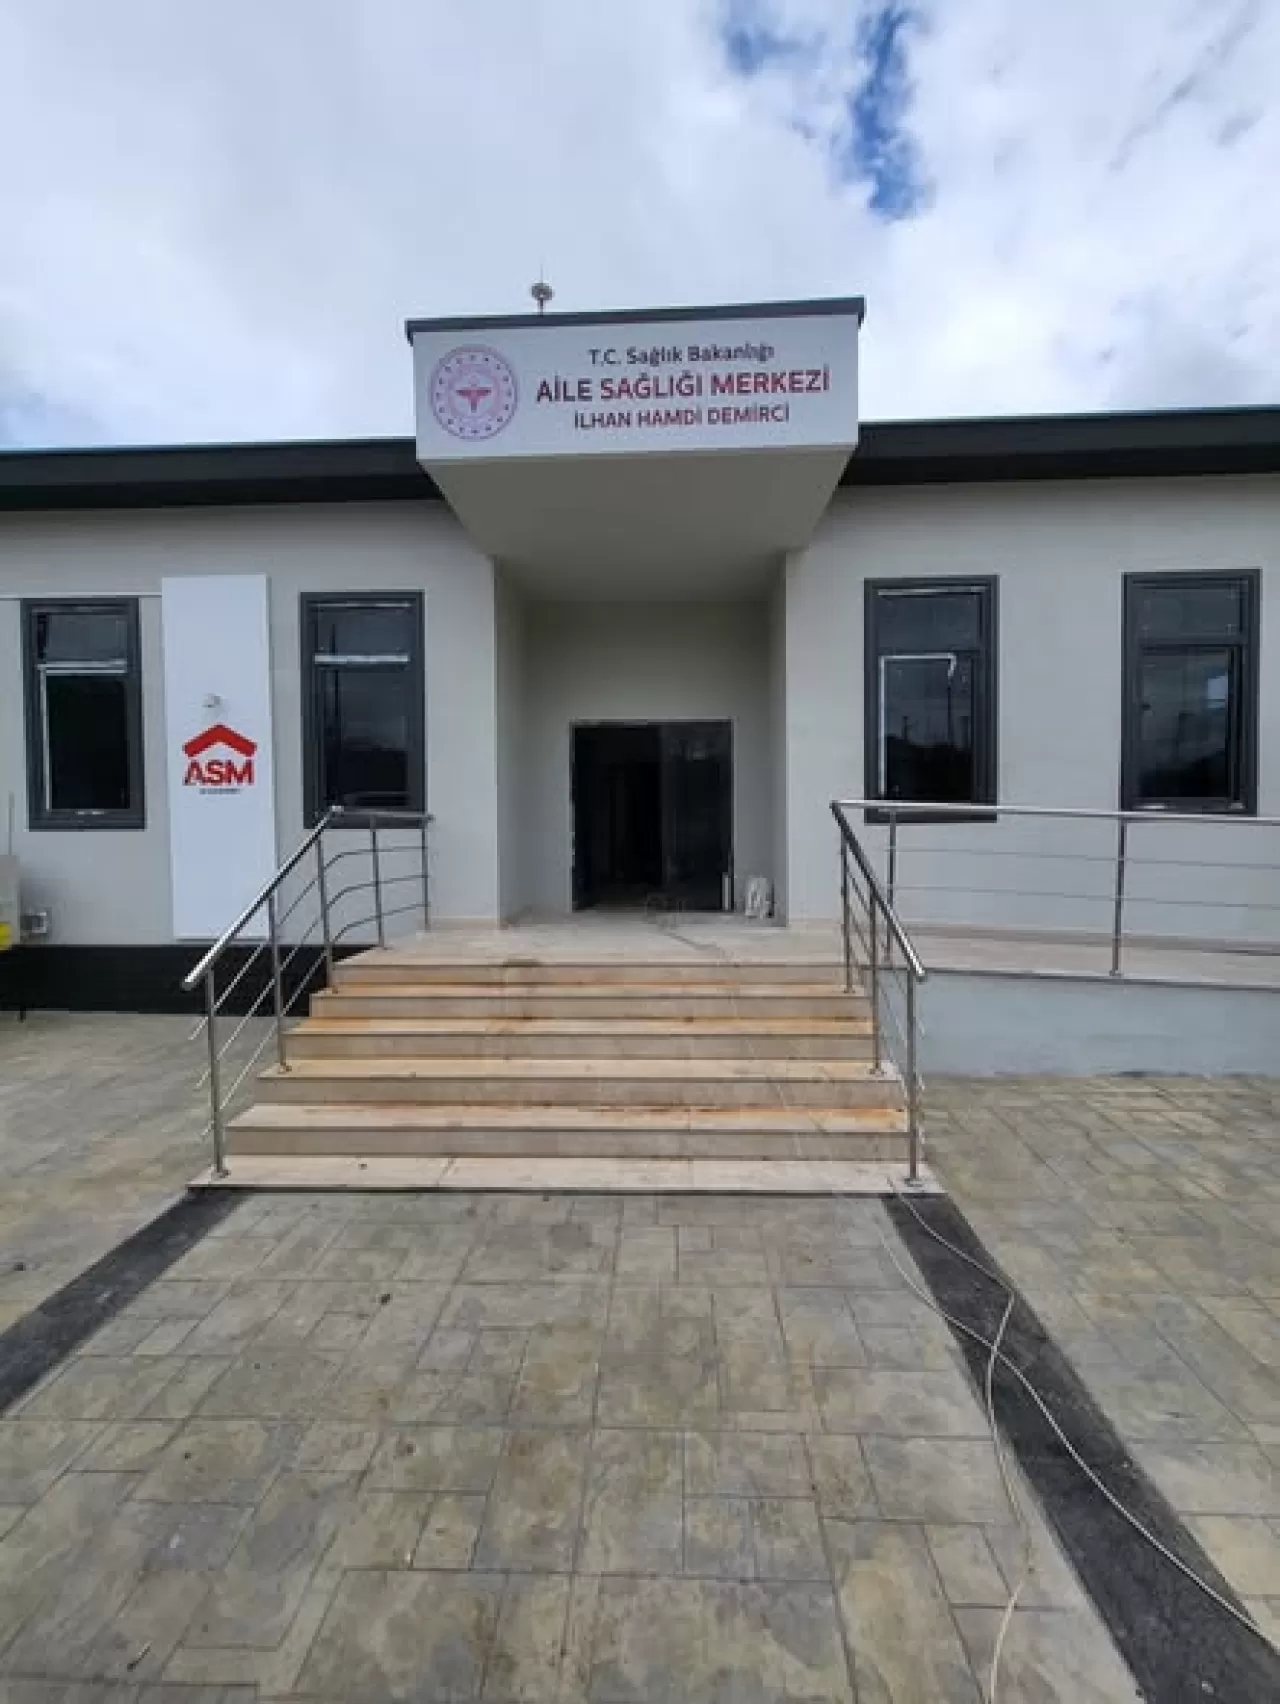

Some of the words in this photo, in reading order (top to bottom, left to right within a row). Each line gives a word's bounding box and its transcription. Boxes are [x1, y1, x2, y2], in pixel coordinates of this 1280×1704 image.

[588, 349, 622, 366] T.C.
[627, 346, 683, 367] Sağlık
[688, 342, 775, 363] Bakanlığı
[536, 376, 592, 403] AİLE
[600, 371, 703, 401] SAĞLIĞI
[711, 364, 829, 395] MERKEZİ
[574, 409, 632, 429] İLHAN
[638, 406, 702, 427] HAMDİ
[708, 404, 790, 425] DEMİRCİ
[183, 759, 255, 786] ASM
